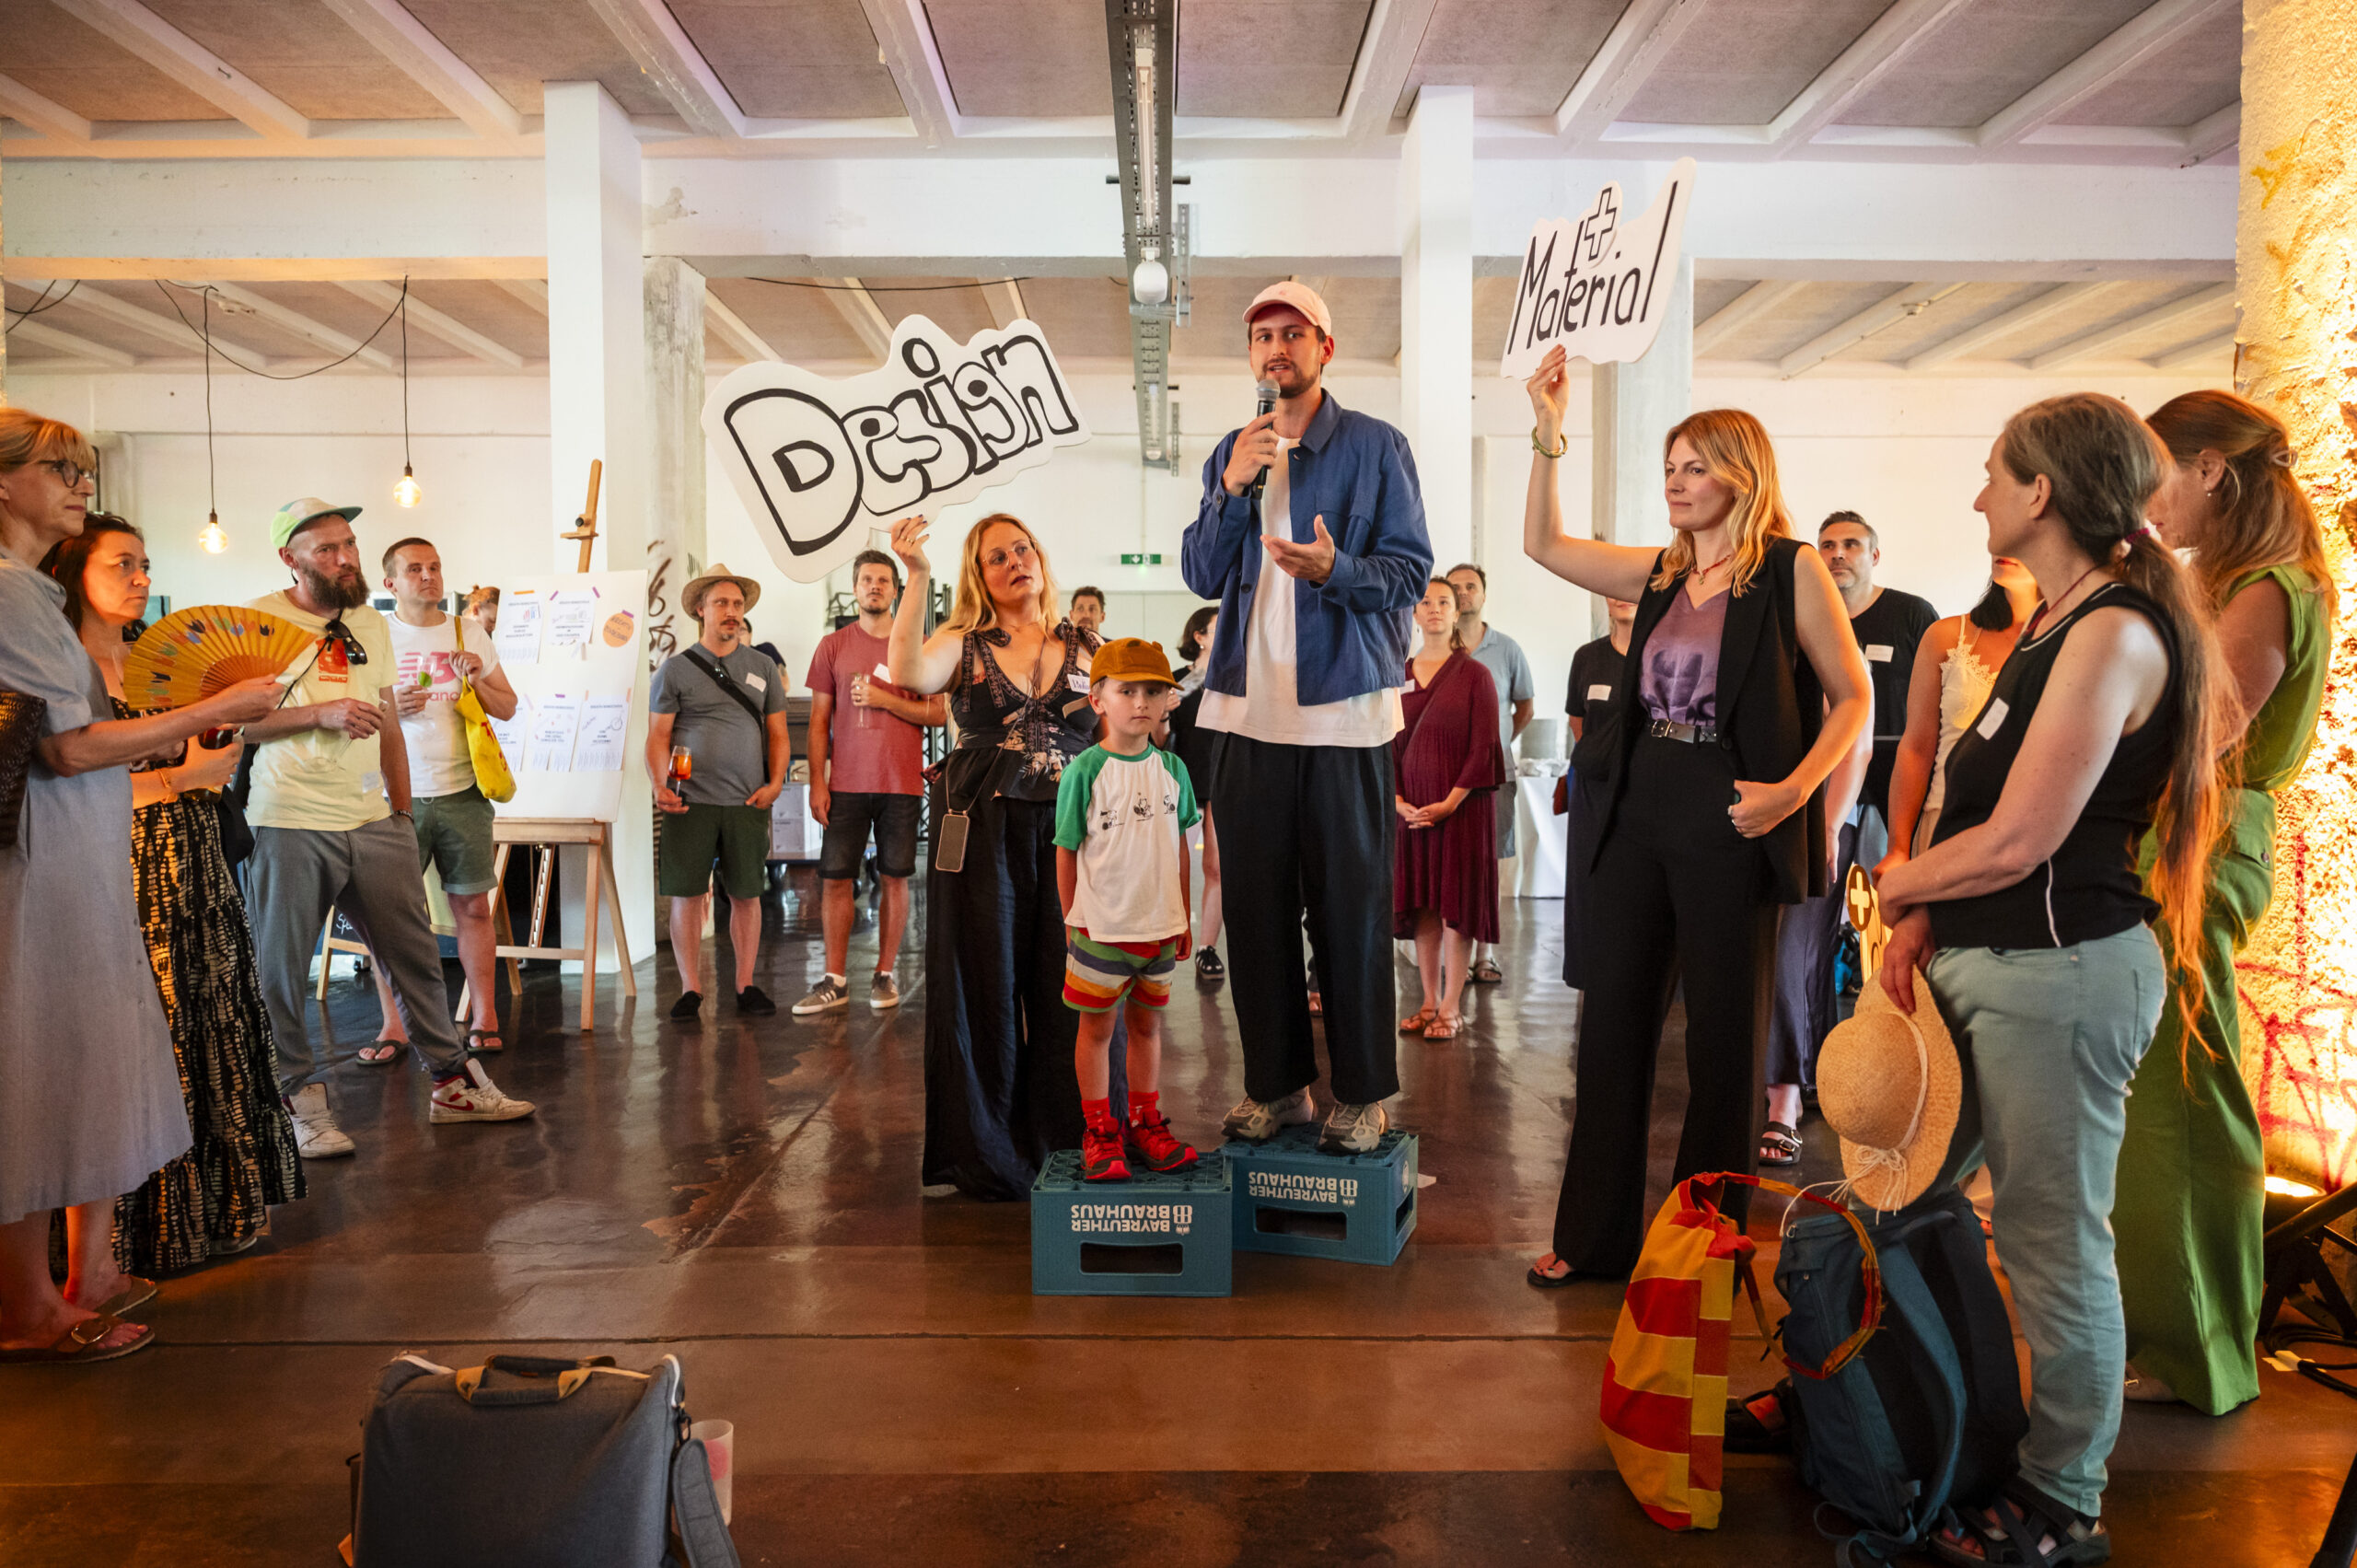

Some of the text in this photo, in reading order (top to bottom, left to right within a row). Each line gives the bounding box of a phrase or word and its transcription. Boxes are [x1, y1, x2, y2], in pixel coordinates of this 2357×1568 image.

[1507, 180, 1678, 355] Material
[724, 334, 1079, 556] Design
[1248, 1171, 1337, 1191] BRAUHAUS
[1248, 1185, 1337, 1203] BAYREUTHER
[1071, 1204, 1170, 1219] BRAUHAUS
[1071, 1219, 1170, 1232] BAYREUTHER
